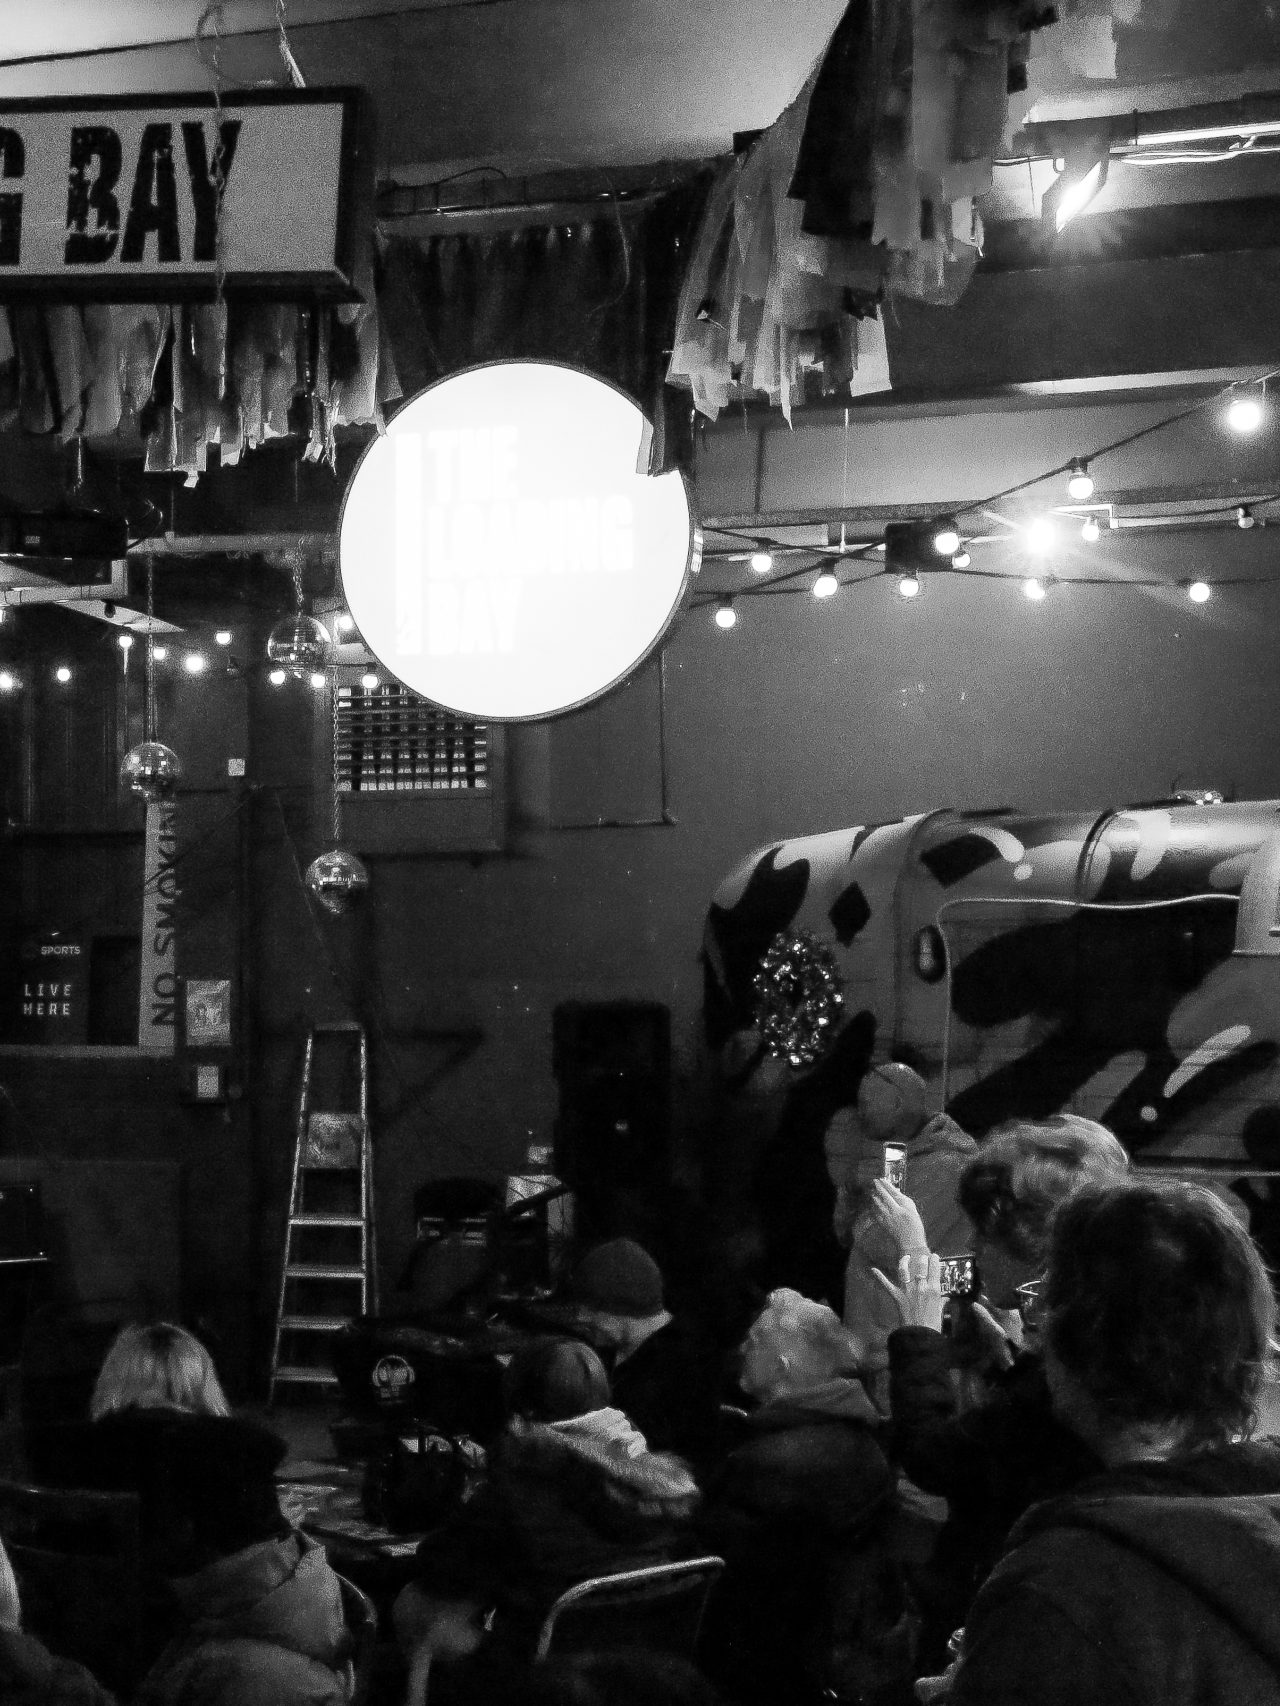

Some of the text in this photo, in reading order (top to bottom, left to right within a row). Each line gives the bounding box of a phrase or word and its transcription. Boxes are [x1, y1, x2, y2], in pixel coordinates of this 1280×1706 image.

[64, 119, 242, 266] BAY
[151, 804, 176, 1026] NO SMOKIN
[40, 945, 81, 955] SPORTS
[23, 983, 72, 997] LIVE
[23, 1002, 71, 1015] HERE
